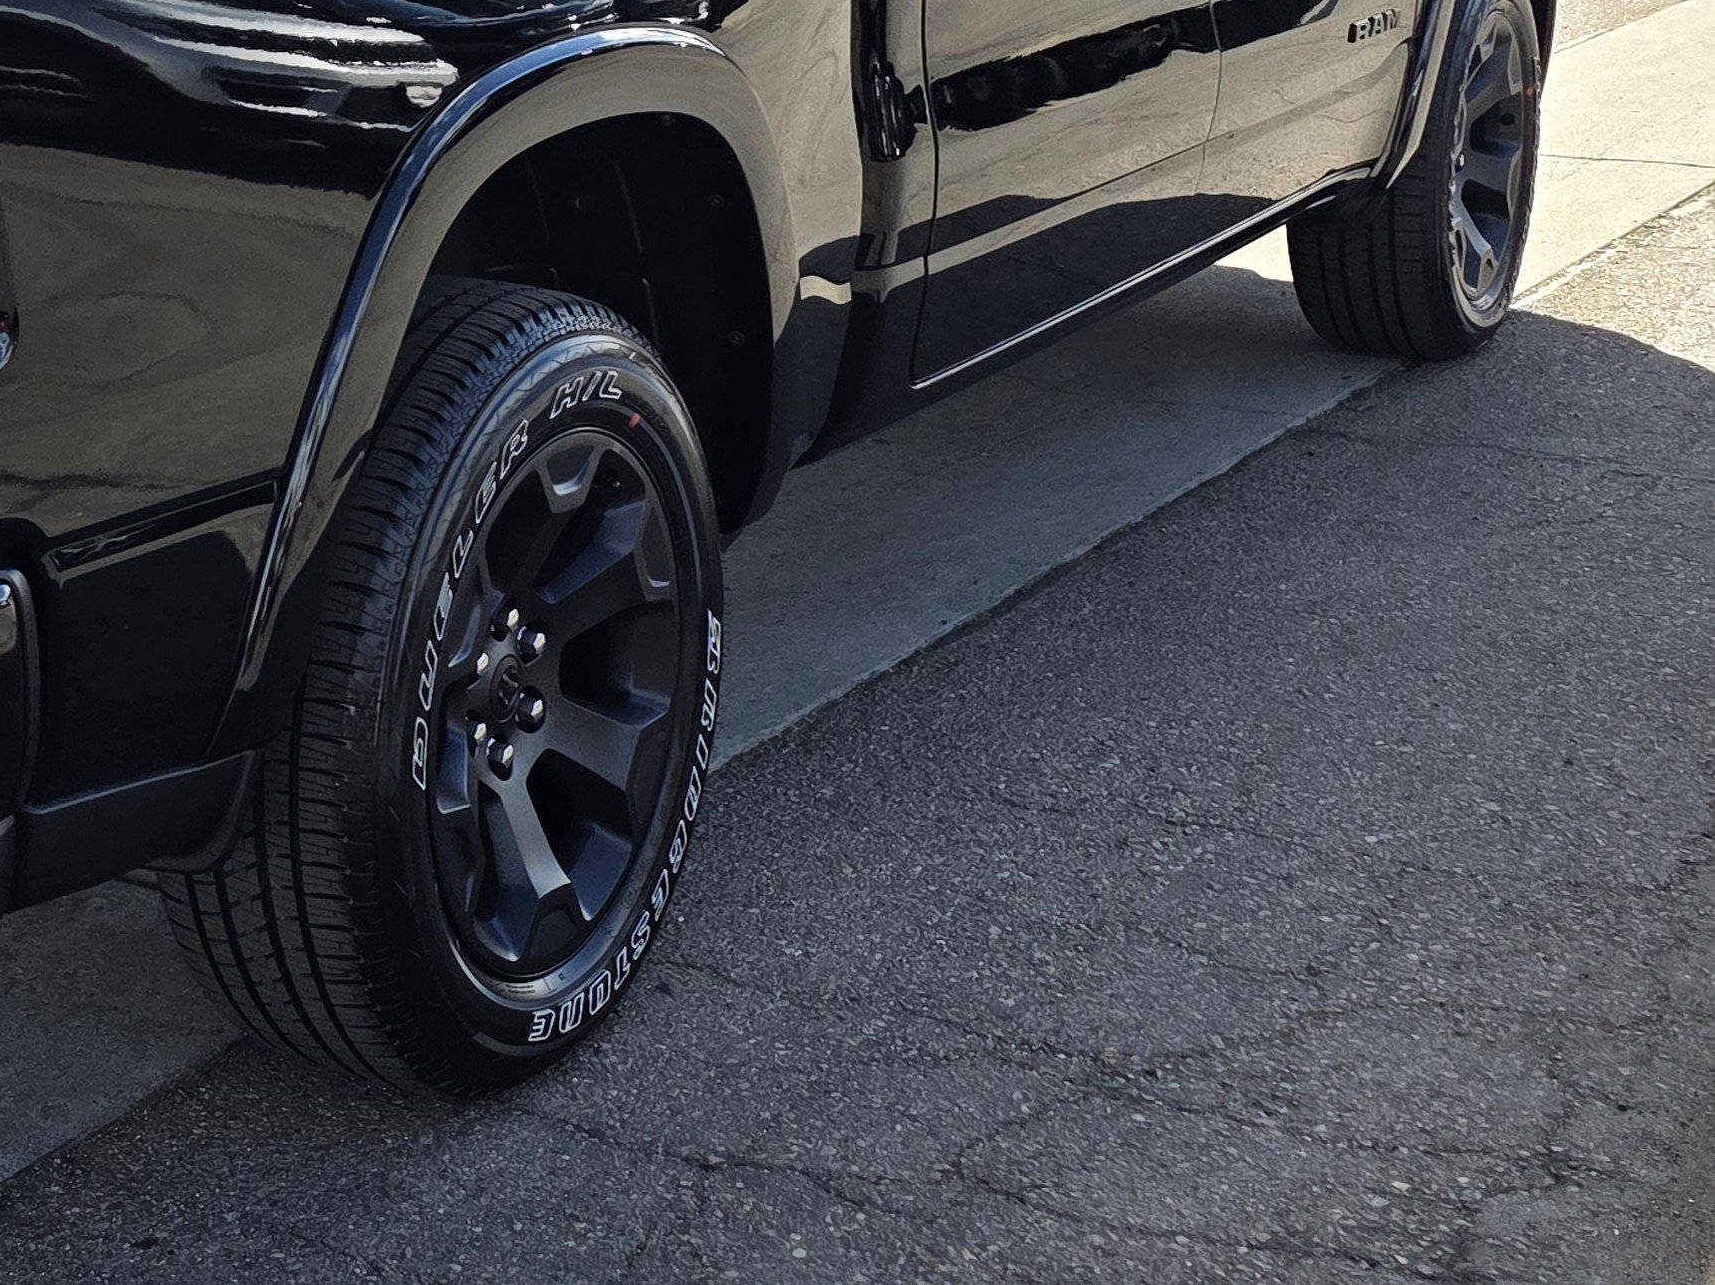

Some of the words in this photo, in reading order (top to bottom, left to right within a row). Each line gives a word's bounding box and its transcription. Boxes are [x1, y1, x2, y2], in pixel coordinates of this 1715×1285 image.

[1350, 9, 1398, 42] RAM
[412, 418, 529, 791] DUELER
[549, 370, 622, 419] H/L
[528, 609, 723, 1042] BRIDGESTONE
